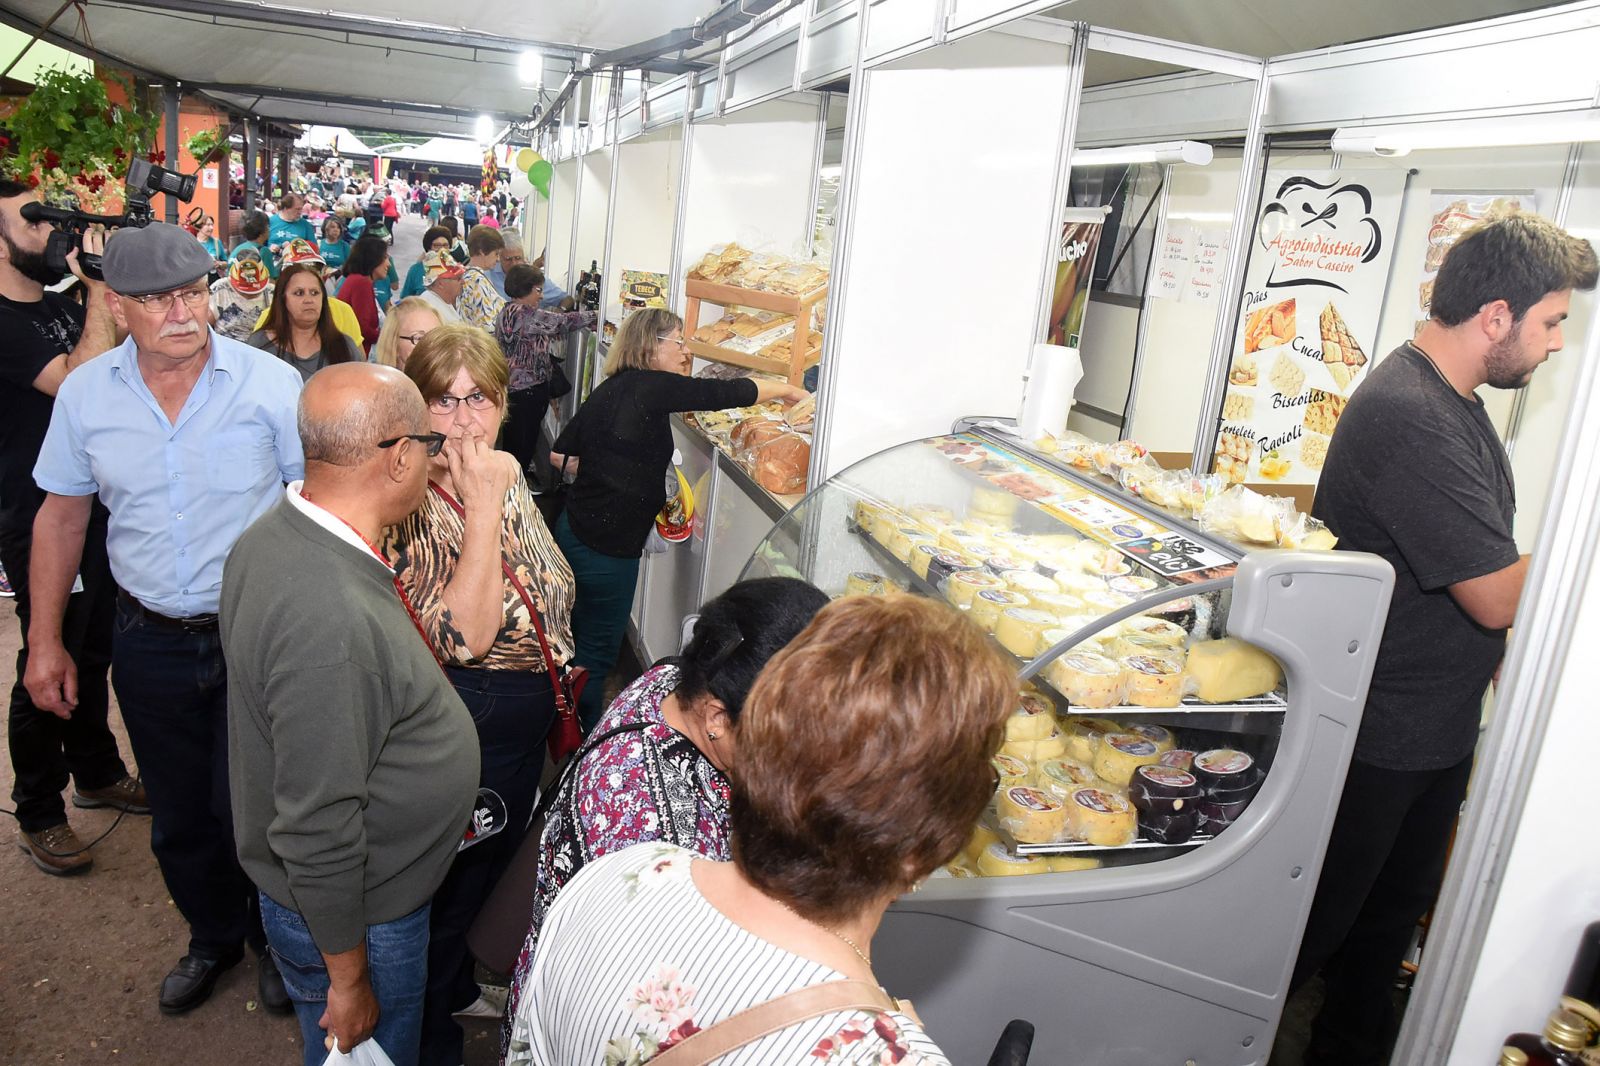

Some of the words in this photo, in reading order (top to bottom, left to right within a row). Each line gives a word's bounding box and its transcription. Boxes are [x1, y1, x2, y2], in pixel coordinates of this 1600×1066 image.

[1267, 231, 1362, 257] Agroindústria
[1282, 251, 1313, 268] Sabor
[1316, 256, 1354, 273] Caseiro
[1292, 336, 1325, 361] Cucas
[1271, 391, 1325, 409] Biscoitos
[1257, 425, 1302, 457] Ravioli
[1149, 552, 1188, 570] elo
